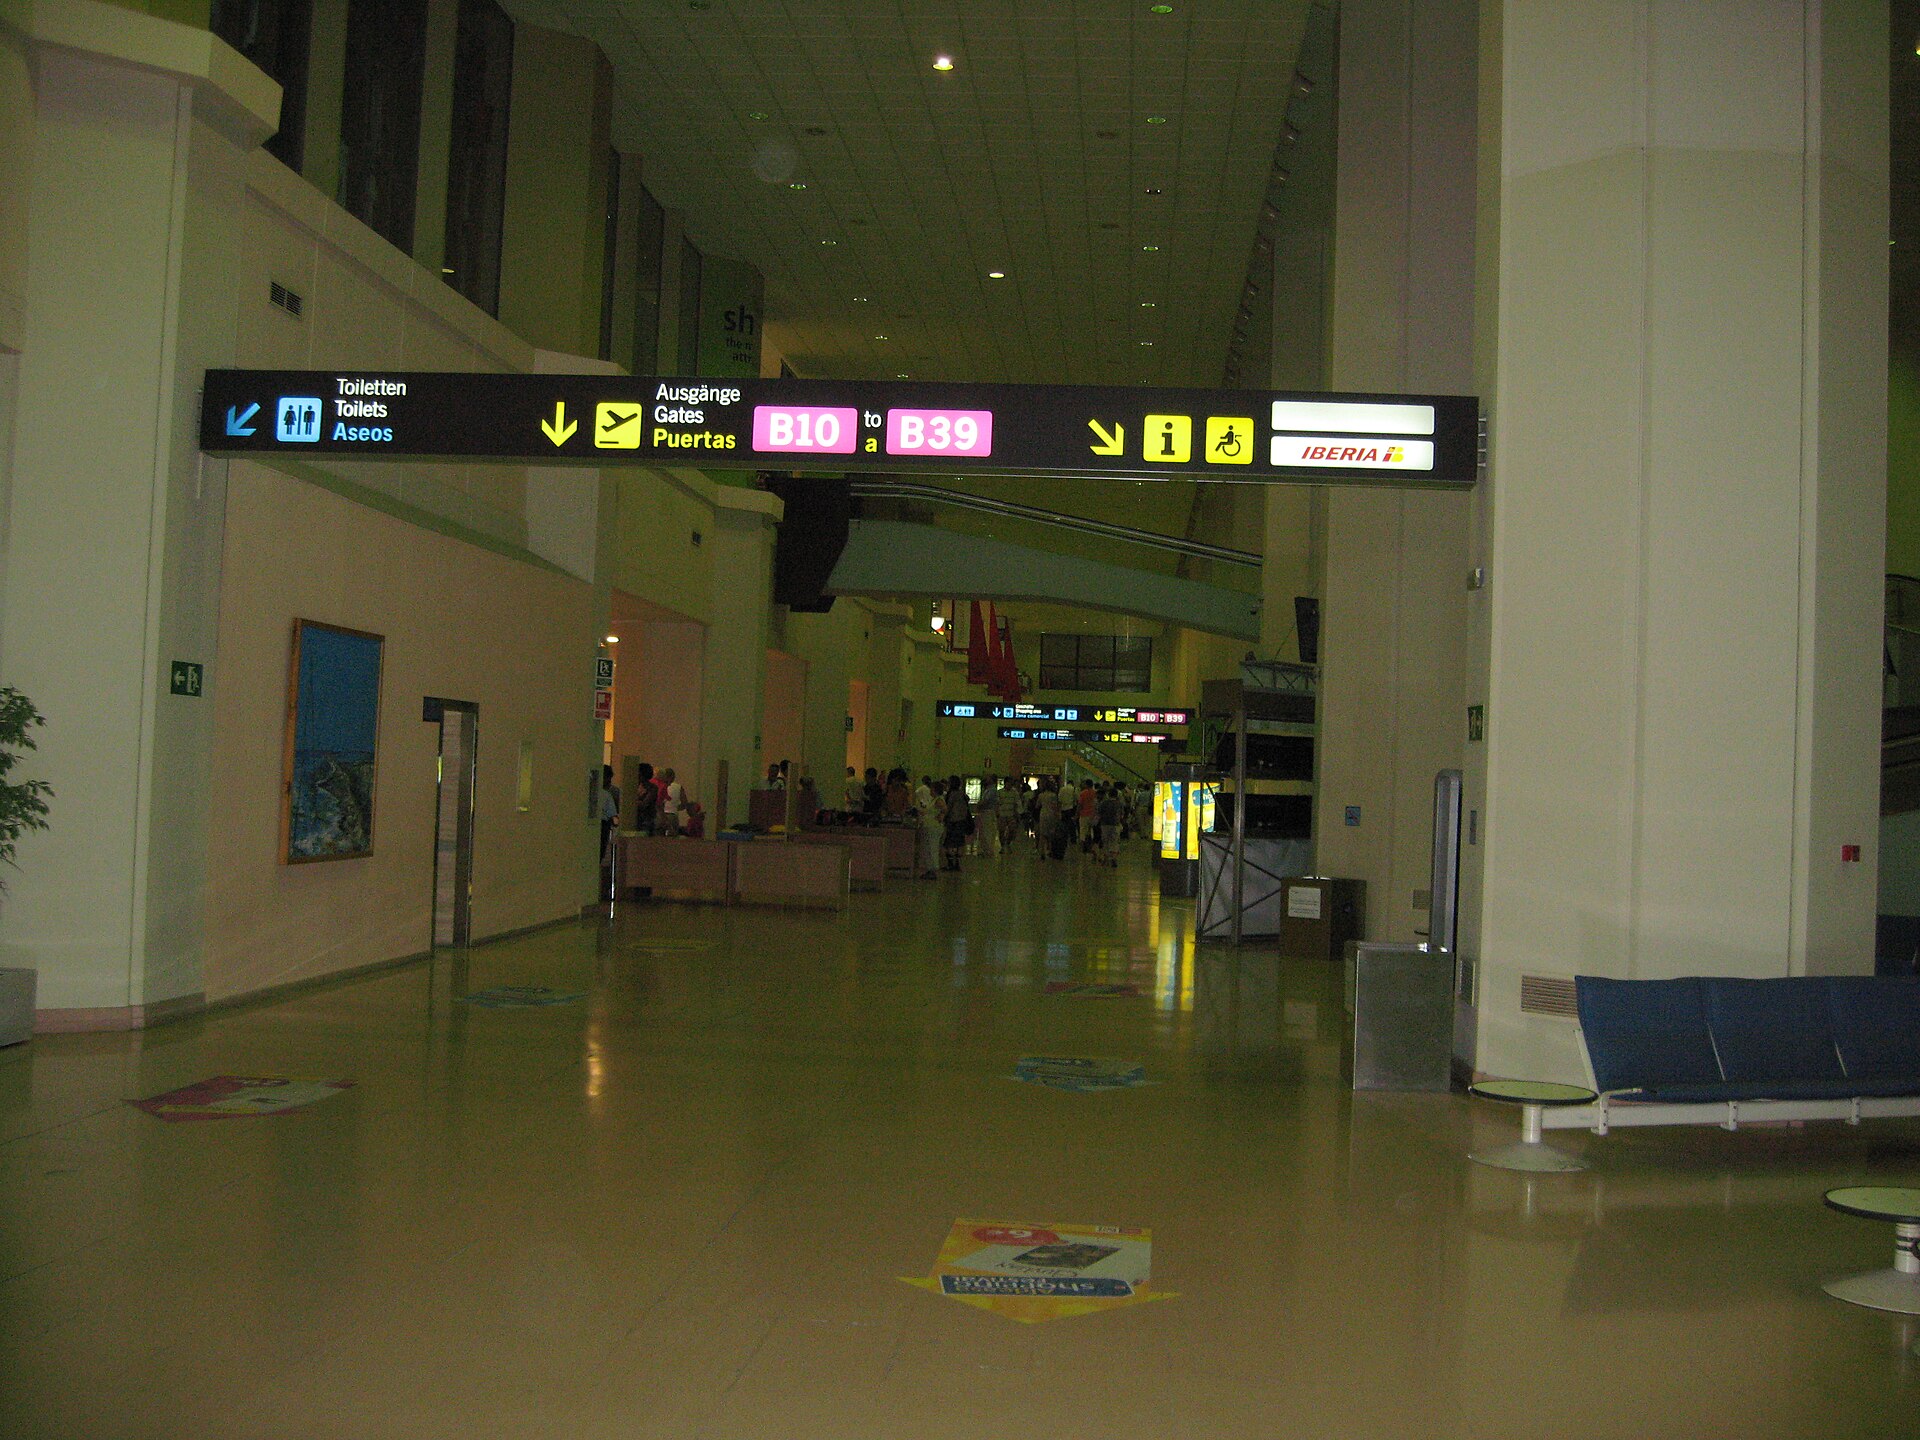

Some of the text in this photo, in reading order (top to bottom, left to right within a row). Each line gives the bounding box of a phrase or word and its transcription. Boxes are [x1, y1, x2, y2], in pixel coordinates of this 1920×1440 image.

[336, 378, 407, 396] Toiletten
[655, 383, 741, 406] Ausgänge
[335, 399, 388, 418] Toilets
[653, 405, 705, 424] Gates
[863, 410, 882, 428] to
[332, 421, 393, 442] Aseos
[653, 427, 736, 450] Puertas
[768, 412, 840, 447] B10
[900, 415, 978, 450] B39
[864, 437, 878, 453] a
[1301, 446, 1378, 462] IBERIA
[1166, 715, 1184, 723] B39
